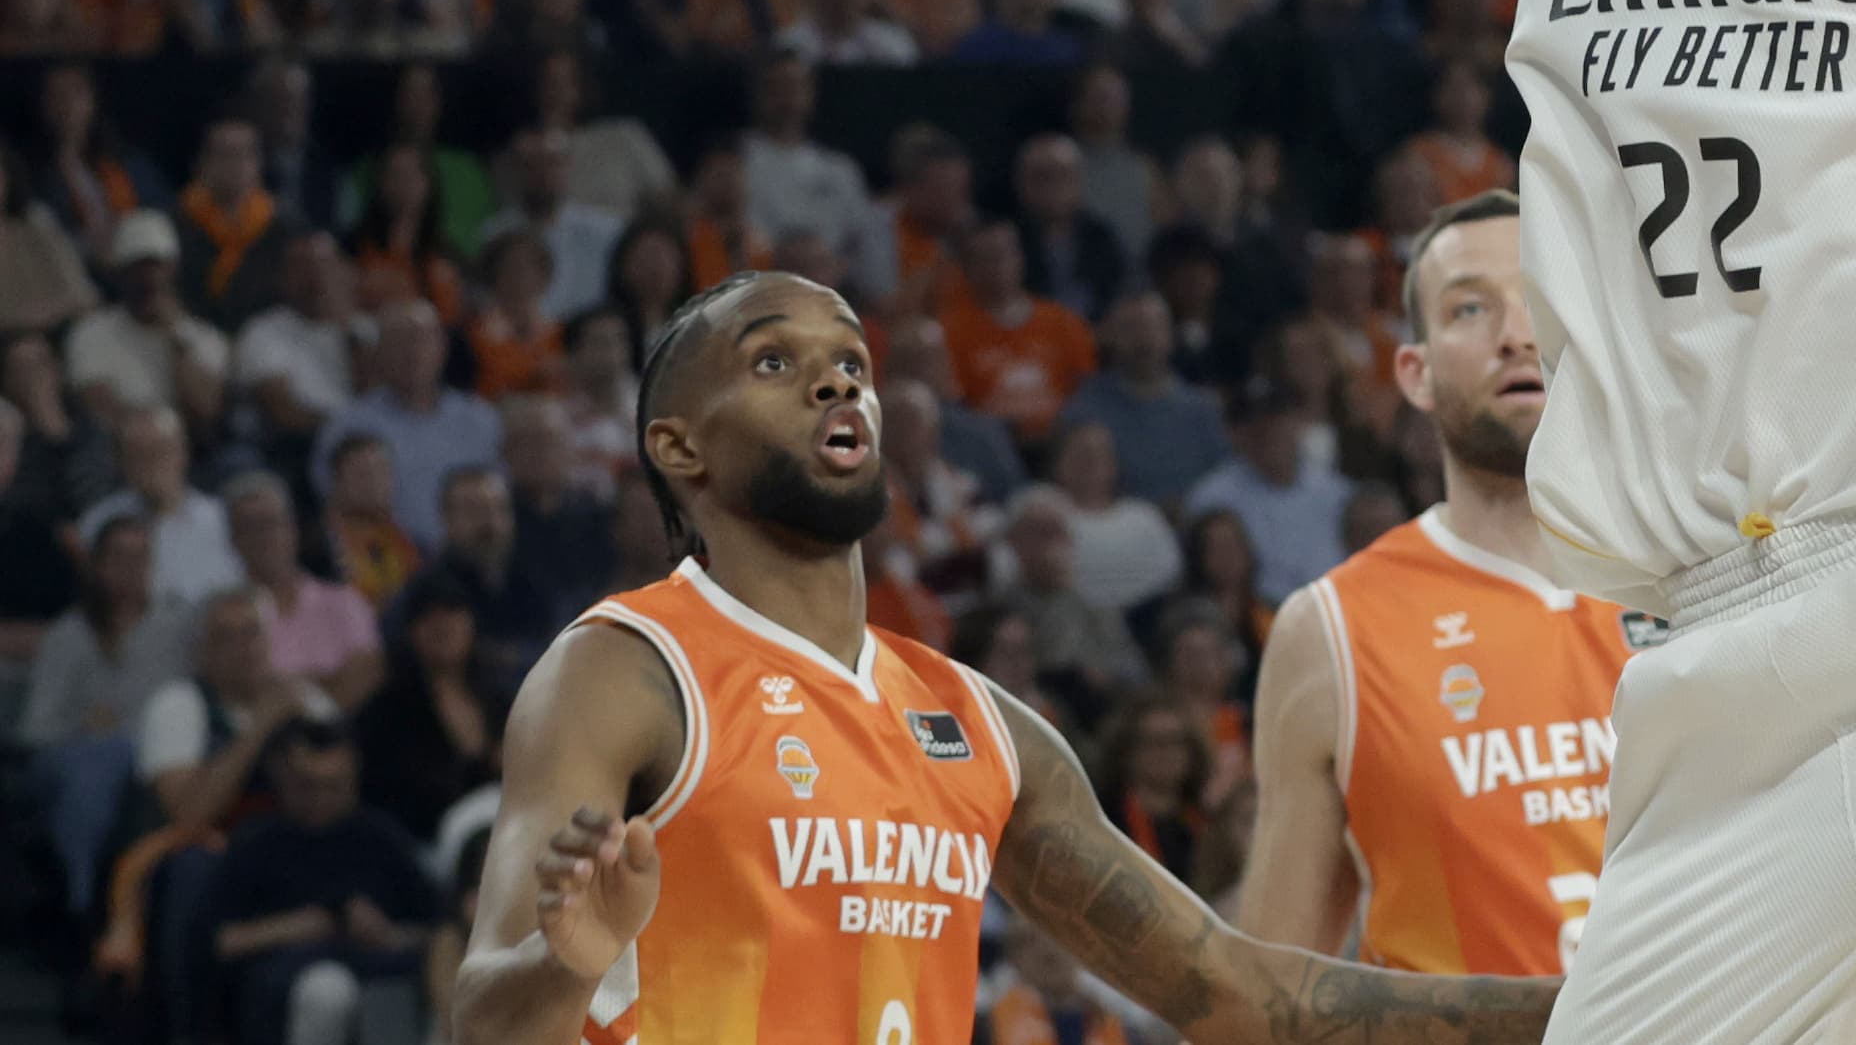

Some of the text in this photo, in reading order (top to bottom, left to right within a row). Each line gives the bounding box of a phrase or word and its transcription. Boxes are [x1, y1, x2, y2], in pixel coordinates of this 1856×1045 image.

[1582, 21, 1849, 97] FLY BETTER
[1618, 136, 1762, 299] 22
